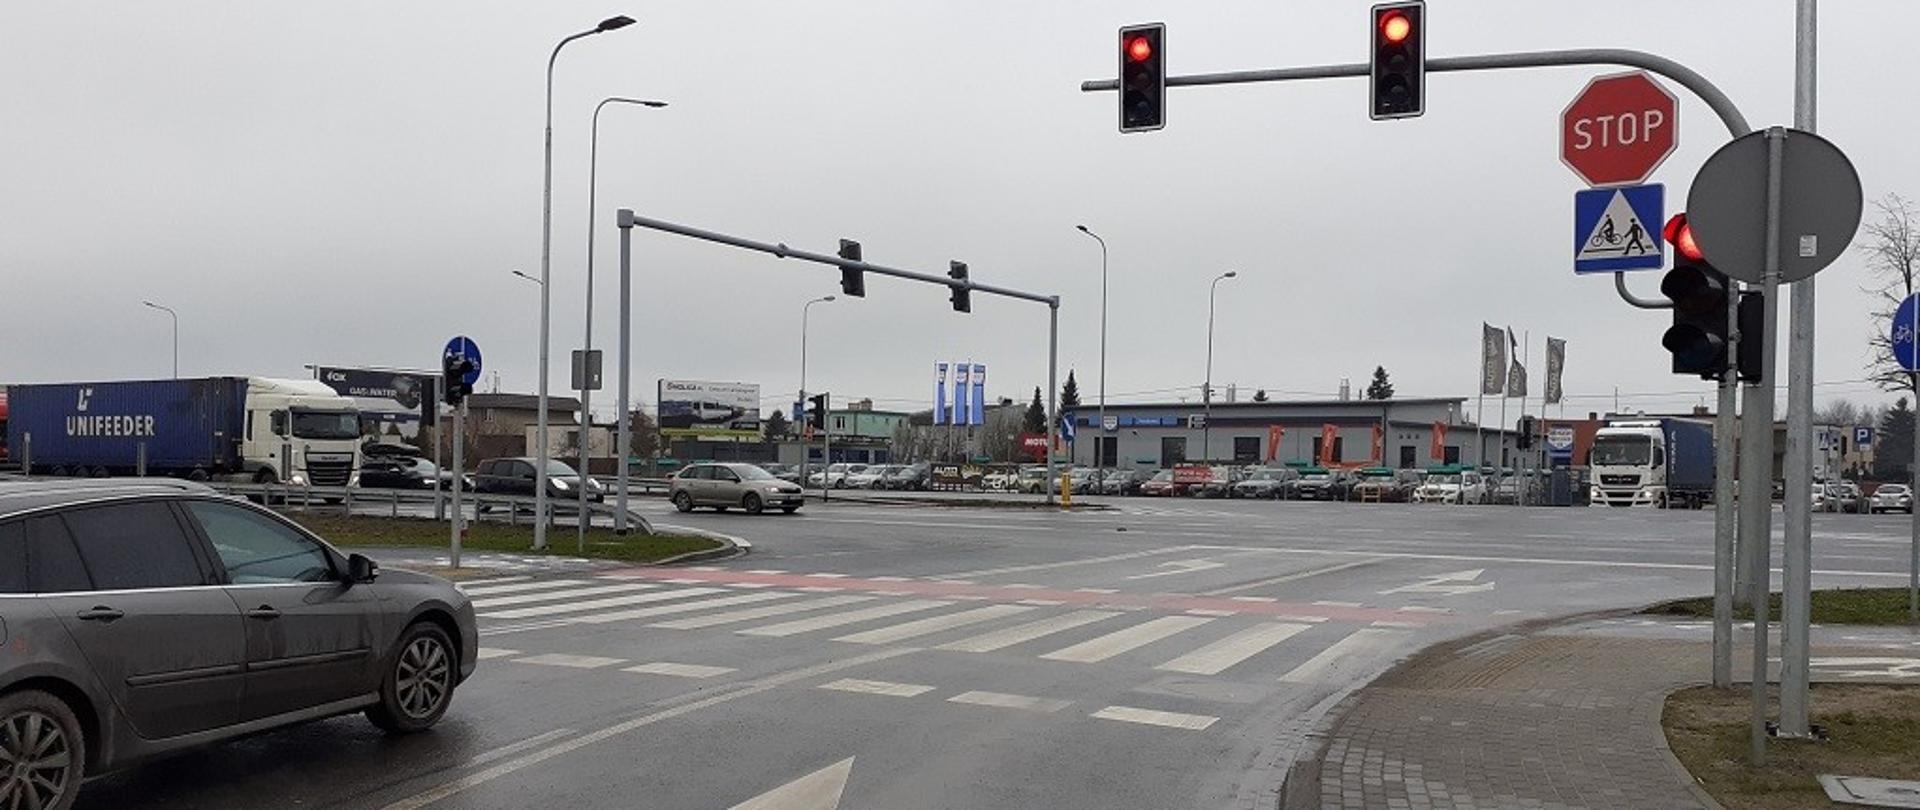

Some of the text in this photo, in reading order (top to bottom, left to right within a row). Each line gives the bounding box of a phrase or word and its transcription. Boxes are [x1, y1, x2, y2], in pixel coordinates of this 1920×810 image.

[1573, 109, 1664, 149] STOP
[66, 415, 155, 436] UNIFEEDER
[1857, 429, 1869, 441] P
